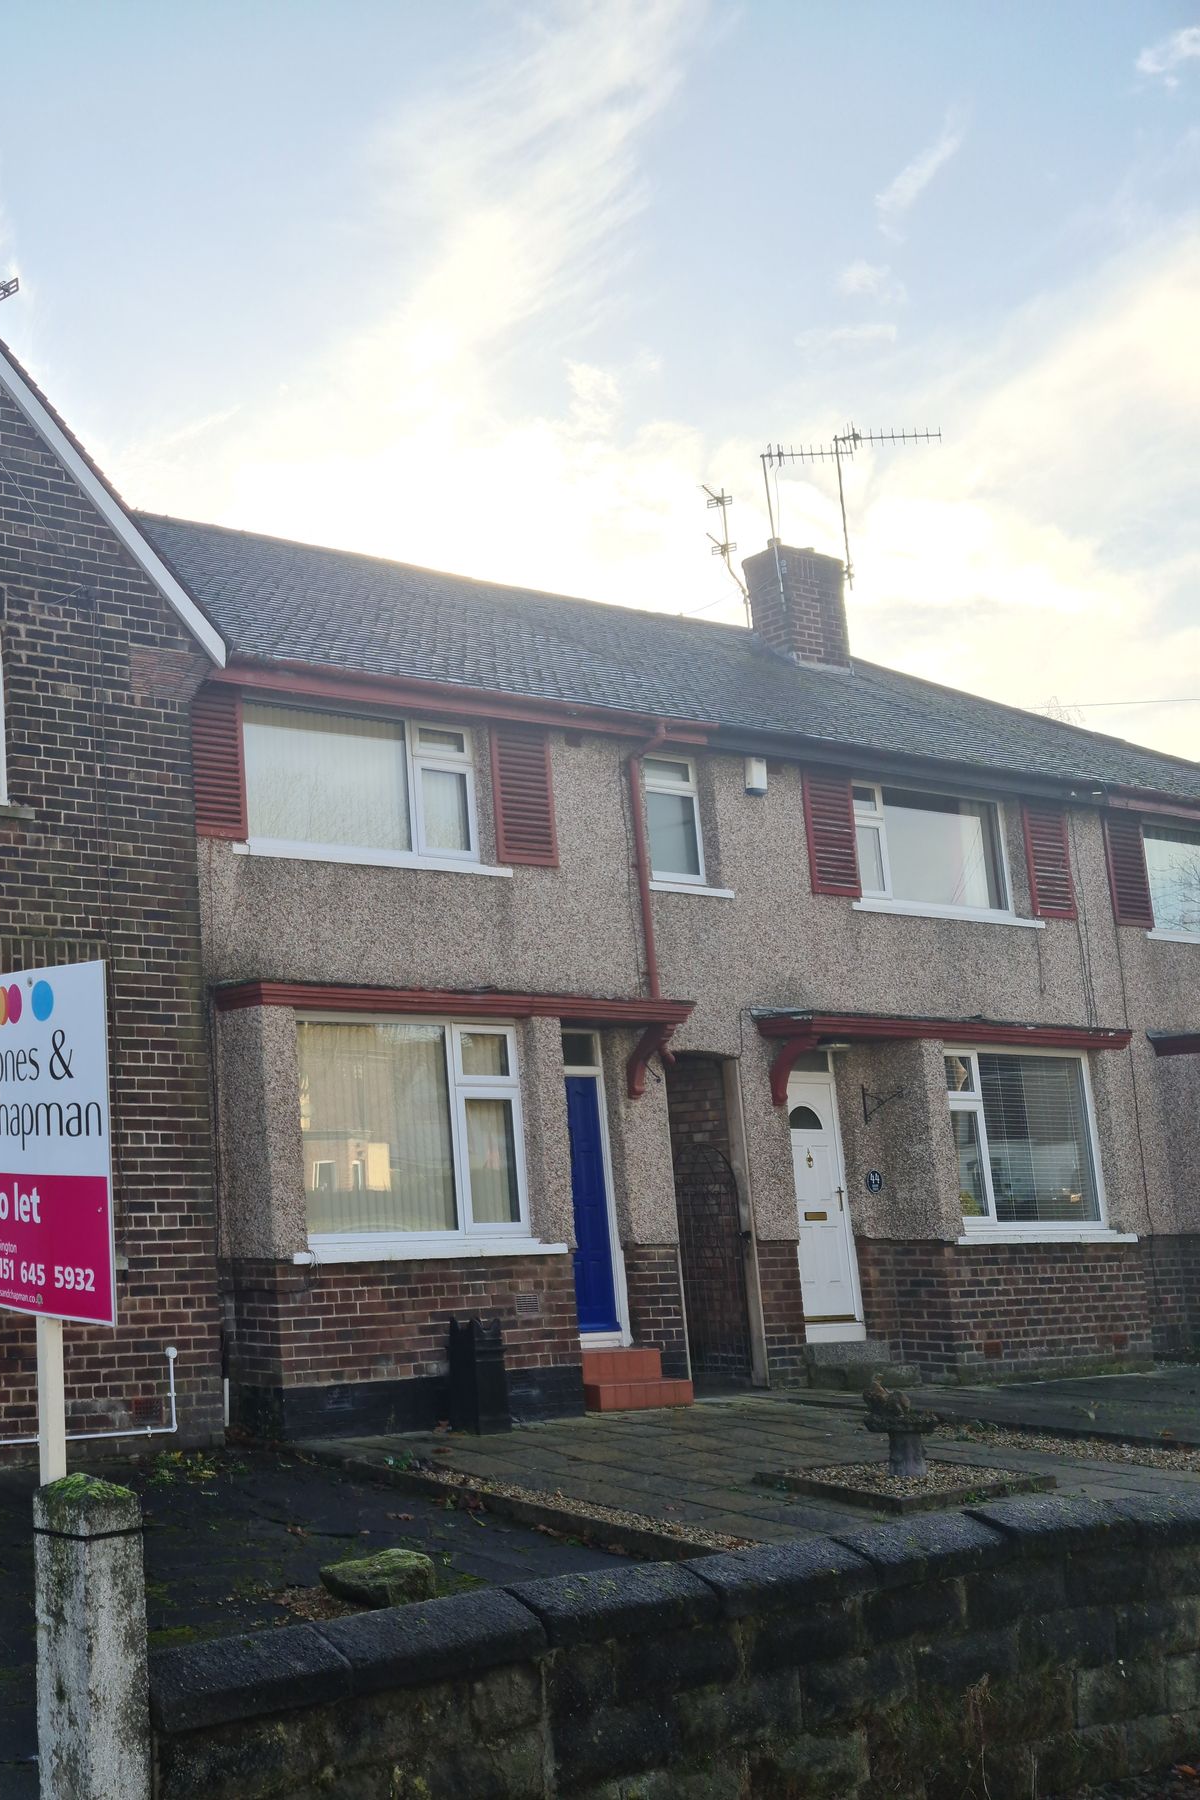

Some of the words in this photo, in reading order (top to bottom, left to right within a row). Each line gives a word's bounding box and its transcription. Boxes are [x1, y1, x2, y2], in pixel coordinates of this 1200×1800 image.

[49, 1029, 75, 1080] &
[14, 1181, 41, 1224] let
[20, 1261, 46, 1286] 645
[54, 1265, 96, 1292] 5932
